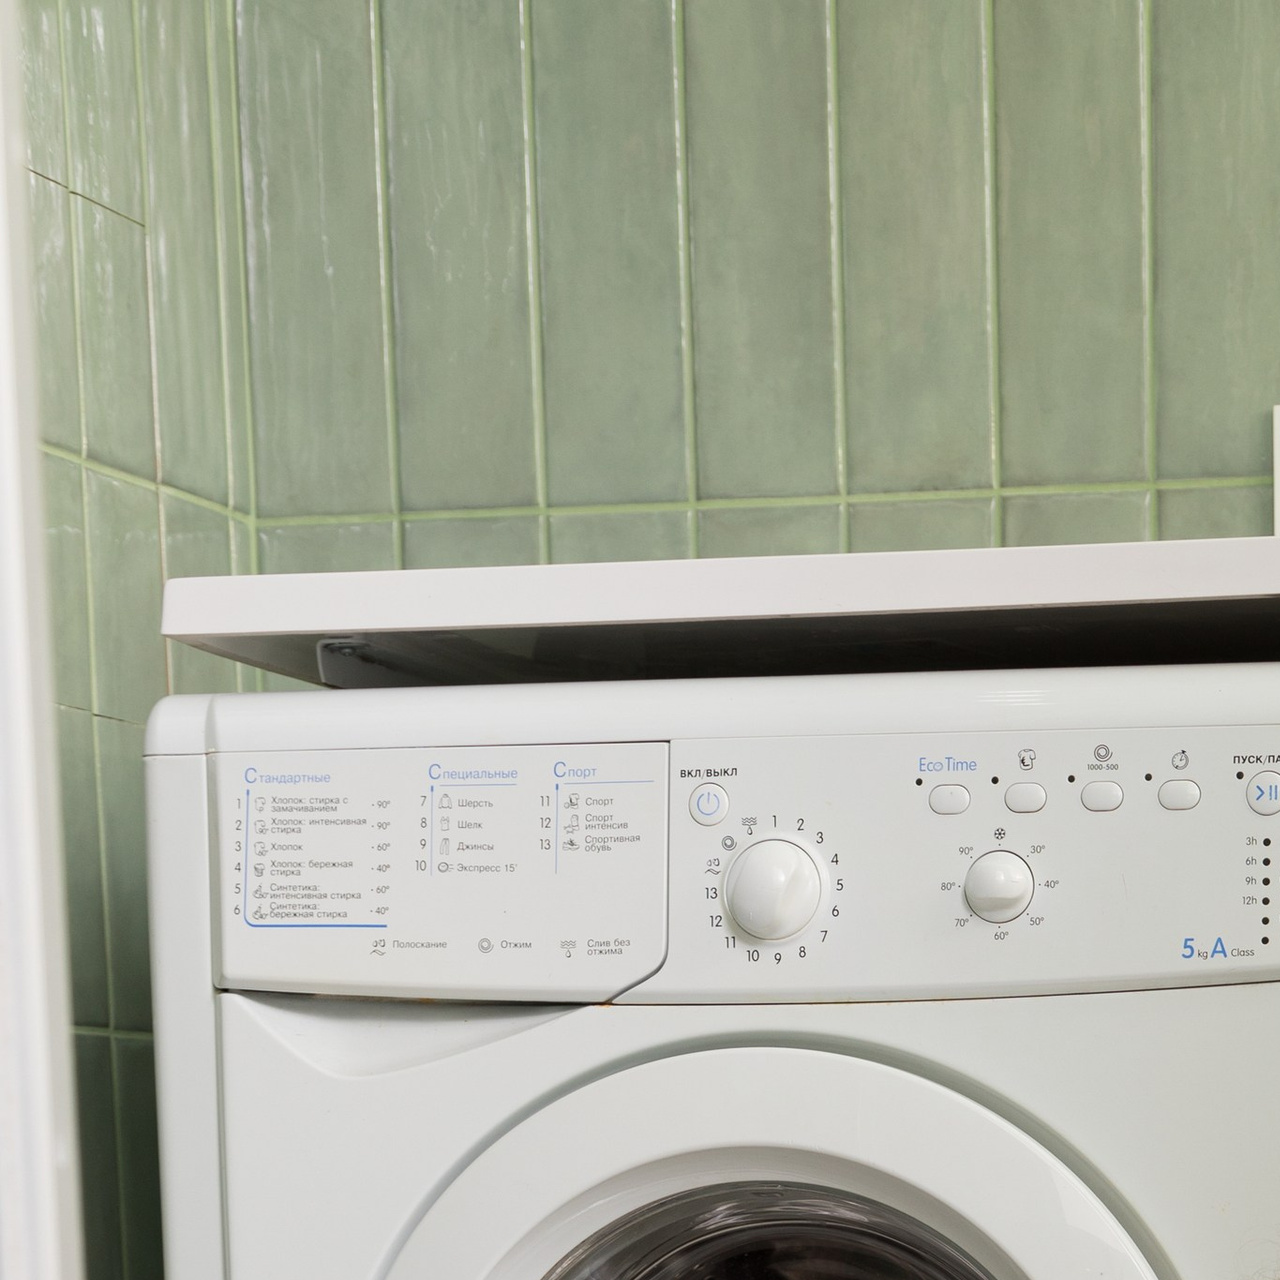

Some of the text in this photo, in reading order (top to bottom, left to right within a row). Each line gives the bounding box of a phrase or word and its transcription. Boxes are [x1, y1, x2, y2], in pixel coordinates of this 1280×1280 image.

[428, 763, 518, 781] Специальные
[553, 761, 597, 779] Спорт
[1086, 763, 1119, 771] 1000-500
[244, 767, 332, 785] Стандартные
[680, 767, 738, 780] ВКЛ/ВЫКЛ
[237, 798, 241, 809] 1
[309, 797, 340, 805] стирка
[342, 797, 349, 805] с
[420, 795, 427, 806] 7
[457, 799, 494, 808] Шерсть
[540, 795, 550, 807] 11
[585, 797, 614, 807] Спорт
[271, 805, 338, 813] замачиванием
[309, 818, 367, 826] интенсивная
[420, 817, 427, 829] 8
[540, 816, 551, 829] 12
[585, 813, 614, 823] Спорт
[772, 815, 778, 828] 1
[235, 819, 242, 831] 2
[457, 821, 483, 829] Шелк
[585, 822, 629, 830] интенсив
[796, 818, 805, 831] 2
[271, 826, 302, 834] стирка
[584, 834, 641, 845] Спортивная
[815, 831, 824, 844] 3
[1245, 836, 1258, 846] 3h
[234, 840, 242, 852] 3
[271, 842, 304, 851] Хлопок
[420, 838, 427, 850] 9
[457, 842, 494, 851] Джинсы
[540, 838, 551, 851] 13
[584, 844, 612, 853] обувь
[958, 846, 974, 856] 90°
[1030, 845, 1046, 854] 30°
[308, 859, 354, 869] бережная
[830, 853, 839, 865] 4
[1245, 856, 1257, 866] 6h
[234, 862, 241, 872] 4
[415, 859, 427, 871] 10
[457, 863, 501, 873] Экспресс
[270, 869, 302, 877] стирка
[835, 878, 844, 891] 5
[1043, 880, 1060, 889] 40°
[1245, 876, 1257, 886] 9h
[234, 882, 241, 895] 5
[940, 882, 956, 891] 80°
[269, 892, 362, 900] интенсивная стирка
[705, 887, 718, 900] 13
[1242, 896, 1258, 906] 12h
[233, 904, 241, 915] 6
[269, 910, 348, 919] бережная стирка
[831, 905, 840, 917] 6
[709, 915, 723, 928] 12
[954, 918, 970, 928] 70°
[1029, 916, 1045, 926] 50°
[820, 930, 828, 943] 7
[993, 931, 1010, 941] 60°
[392, 940, 448, 949] Полоскание
[500, 940, 532, 949] Отжим
[587, 938, 631, 948] Слив без
[725, 936, 737, 949] 11
[587, 946, 623, 956] отжима
[798, 946, 807, 959] 8
[1181, 936, 1255, 960] 5 kg A Class
[746, 949, 760, 962] 10
[774, 952, 782, 965] 9
